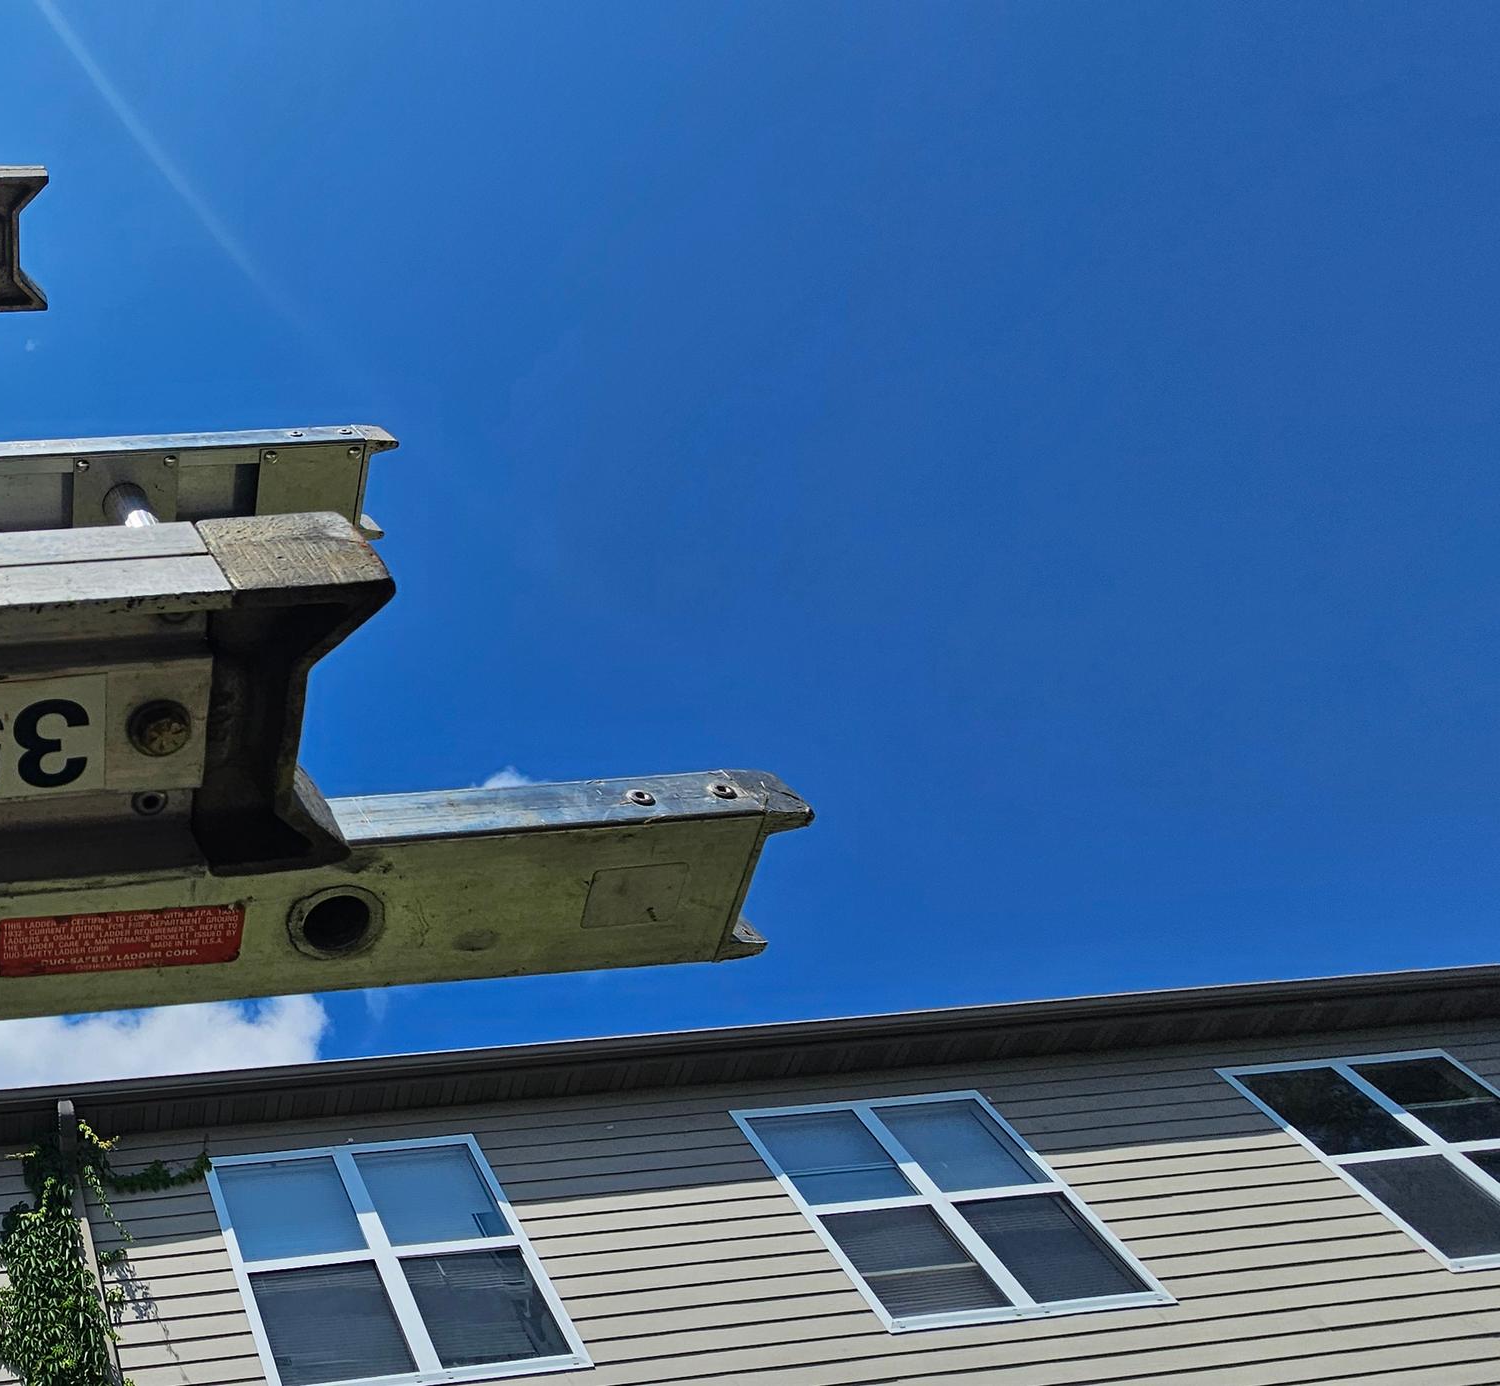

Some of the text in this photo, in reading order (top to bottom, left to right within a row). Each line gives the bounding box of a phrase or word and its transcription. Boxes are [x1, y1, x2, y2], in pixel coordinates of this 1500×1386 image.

[24, 920, 56, 928] LADDER
[28, 927, 65, 935] CURRENT
[150, 917, 200, 926] DEPARTMENT
[206, 914, 238, 922] GROUND
[3, 935, 39, 944] LADDERS
[52, 933, 74, 941] OSHA
[99, 929, 130, 937] LADDER
[22, 942, 53, 950] LADDER
[58, 940, 78, 948] CARE
[94, 935, 149, 945] MAINTENANCE
[154, 932, 188, 941] BOOKLET
[194, 930, 221, 938] ISSUED
[3, 949, 51, 959] DUO-SAFETY
[54, 946, 85, 955] LADDER
[150, 940, 174, 948] MADE
[116, 951, 161, 960] LADDER
[165, 948, 198, 957] CORP.
